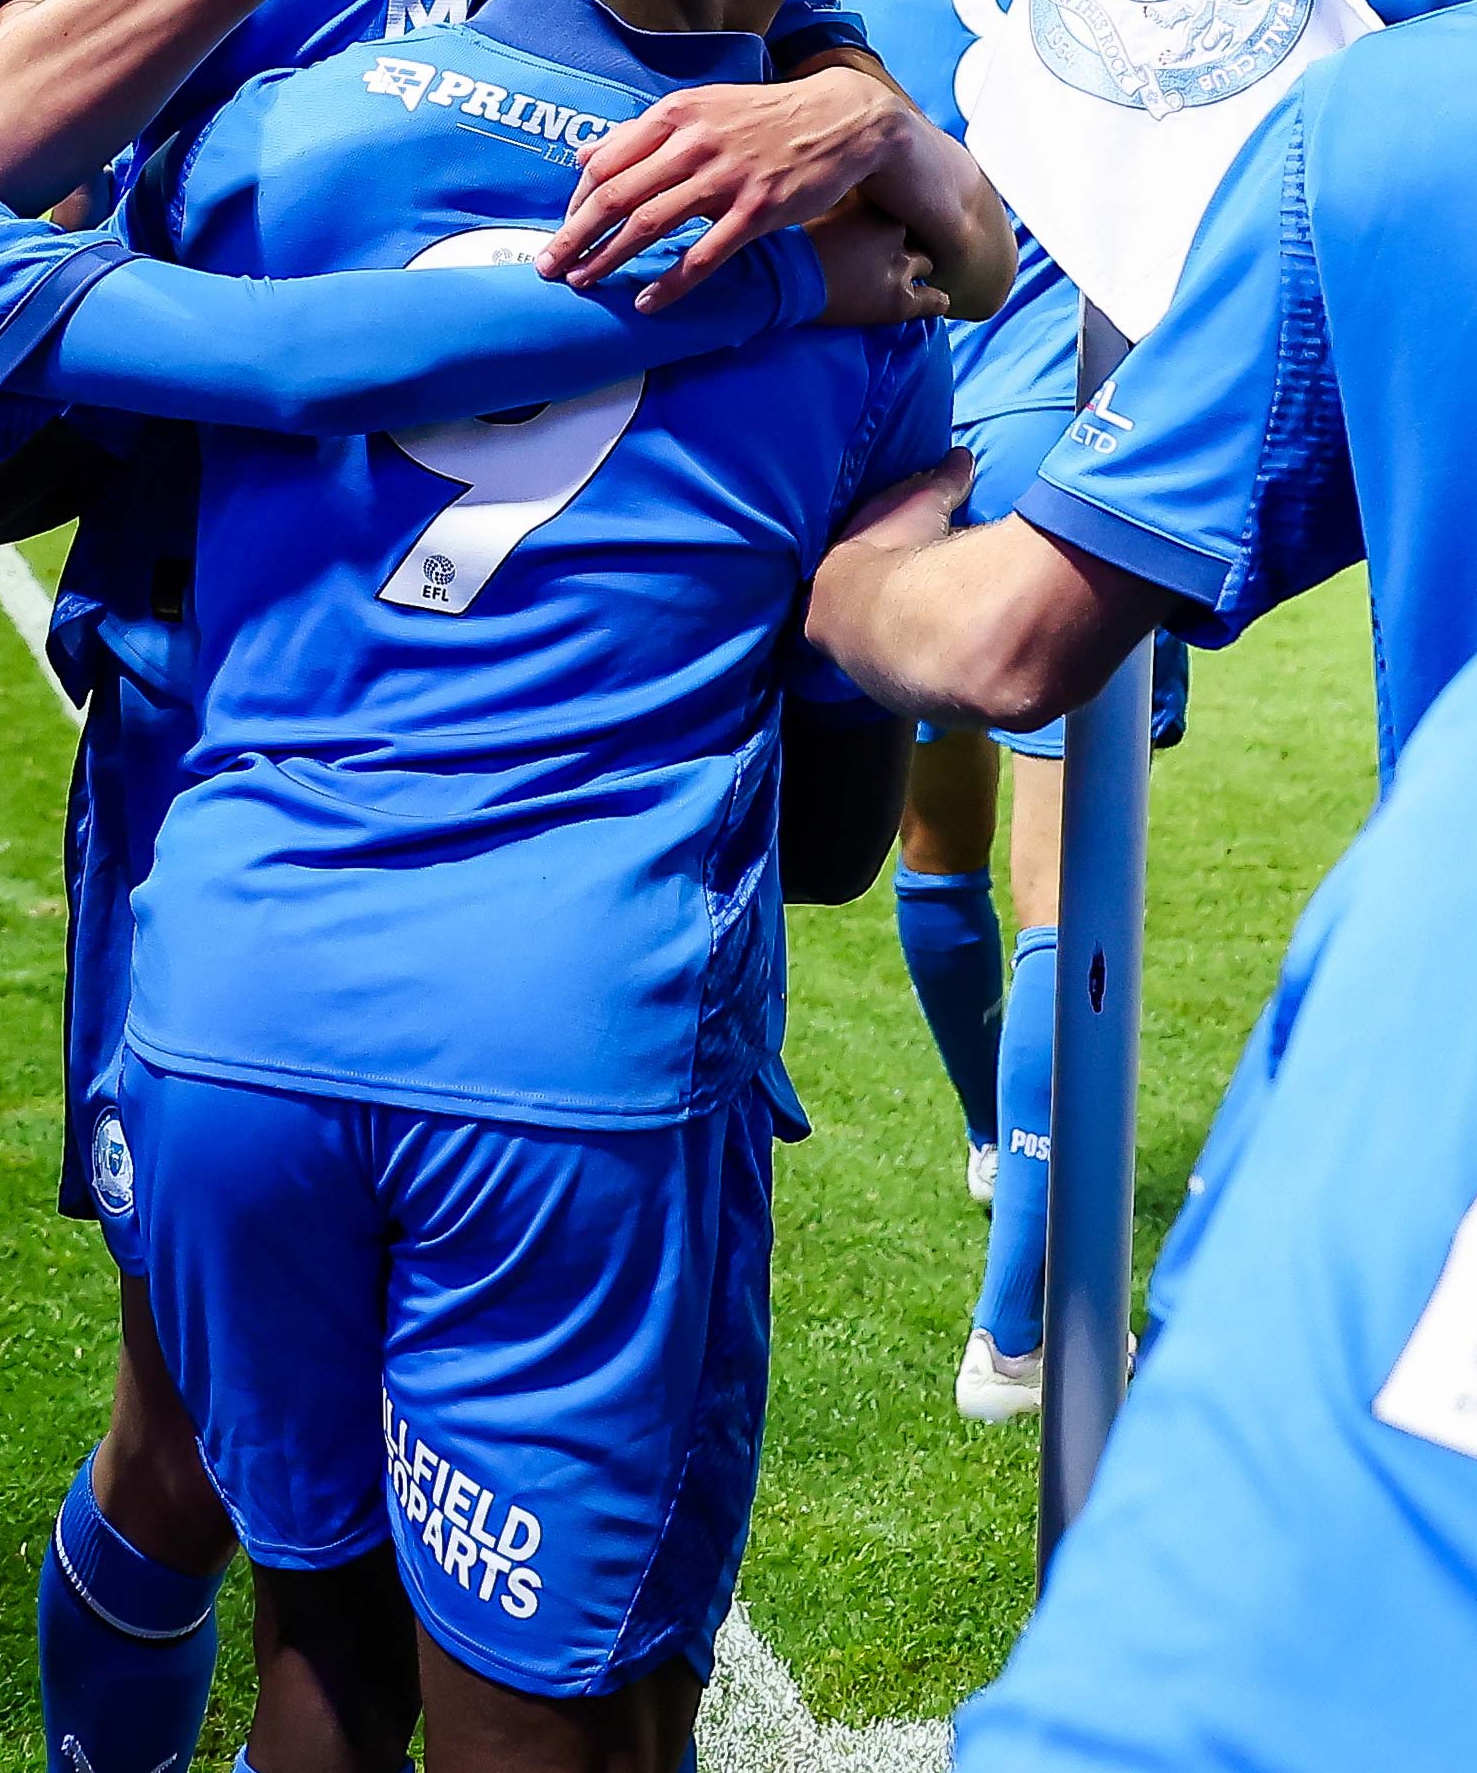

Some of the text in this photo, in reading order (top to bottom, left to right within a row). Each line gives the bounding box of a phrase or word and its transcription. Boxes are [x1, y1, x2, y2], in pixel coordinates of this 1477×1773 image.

[1099, 31, 1133, 85] ROCK
[1198, 54, 1256, 91] CLUB
[427, 69, 620, 148] PRINC
[1070, 422, 1118, 455] LTD
[422, 584, 450, 603] EFL
[1010, 1128, 1051, 1162] POS
